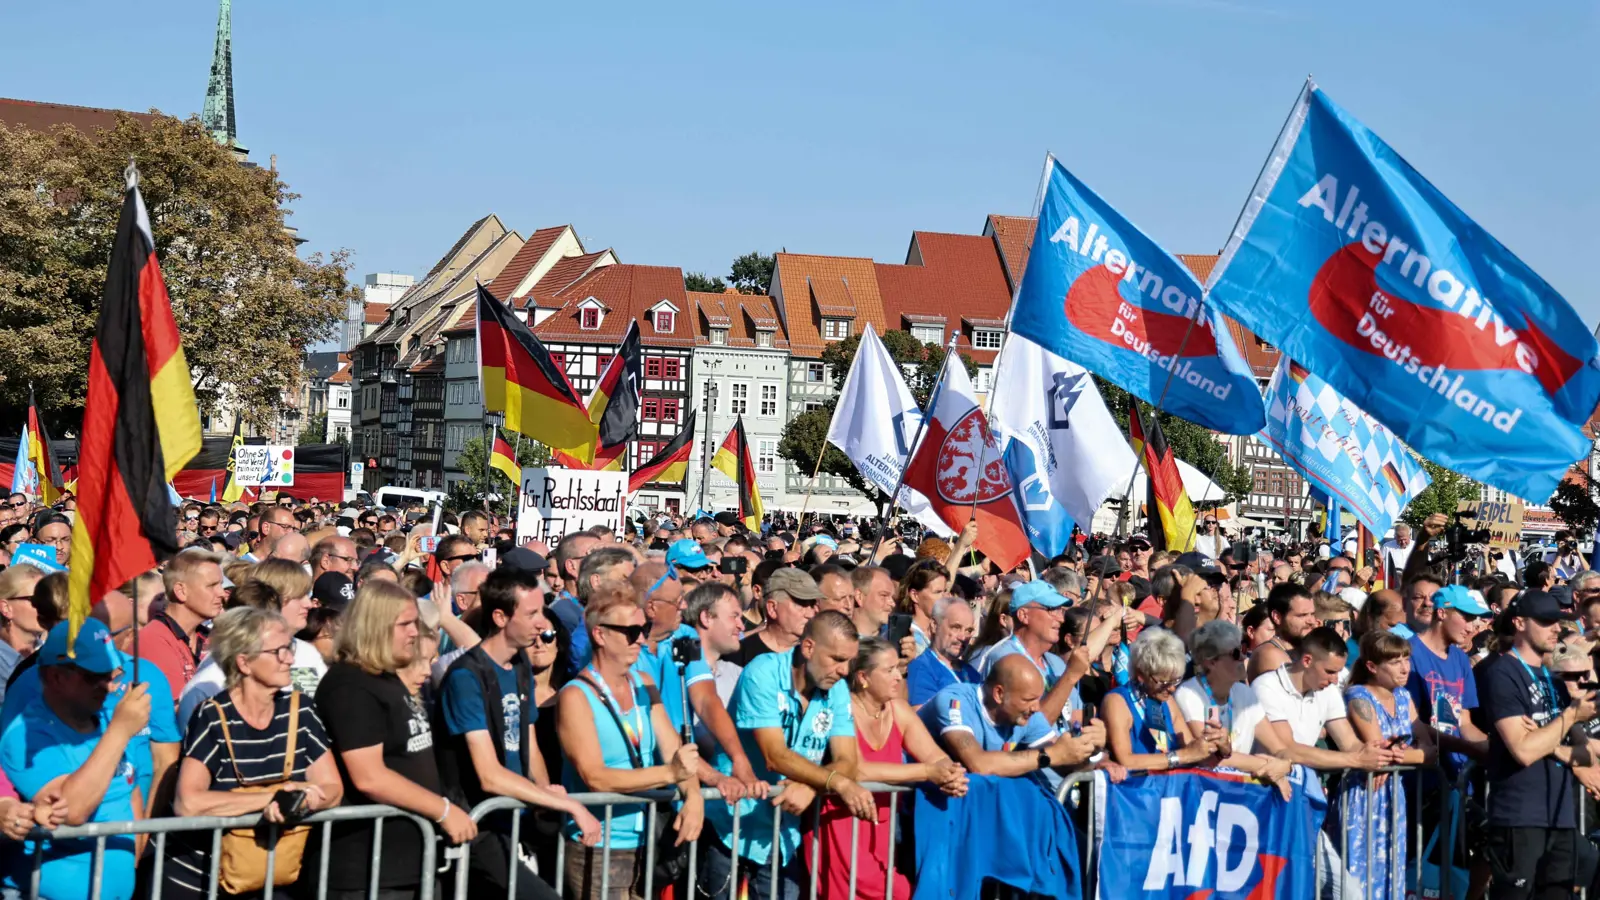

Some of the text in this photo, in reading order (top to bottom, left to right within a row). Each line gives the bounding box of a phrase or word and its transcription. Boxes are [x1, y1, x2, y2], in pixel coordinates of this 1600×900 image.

[1050, 216, 1216, 338] Alternati
[1297, 173, 1539, 375] Alternative
[1117, 302, 1138, 324] für
[1368, 291, 1395, 320] für
[1110, 317, 1232, 402] Deutschland
[1356, 312, 1523, 434] Deutschland
[238, 448, 257, 459] Ohne
[865, 453, 912, 494] ALTERNAVE
[882, 452, 905, 473] JUNG
[523, 476, 621, 513] für Rechtsstaat
[861, 462, 909, 502] BRANDENBRG
[1143, 790, 1259, 892] AfD
